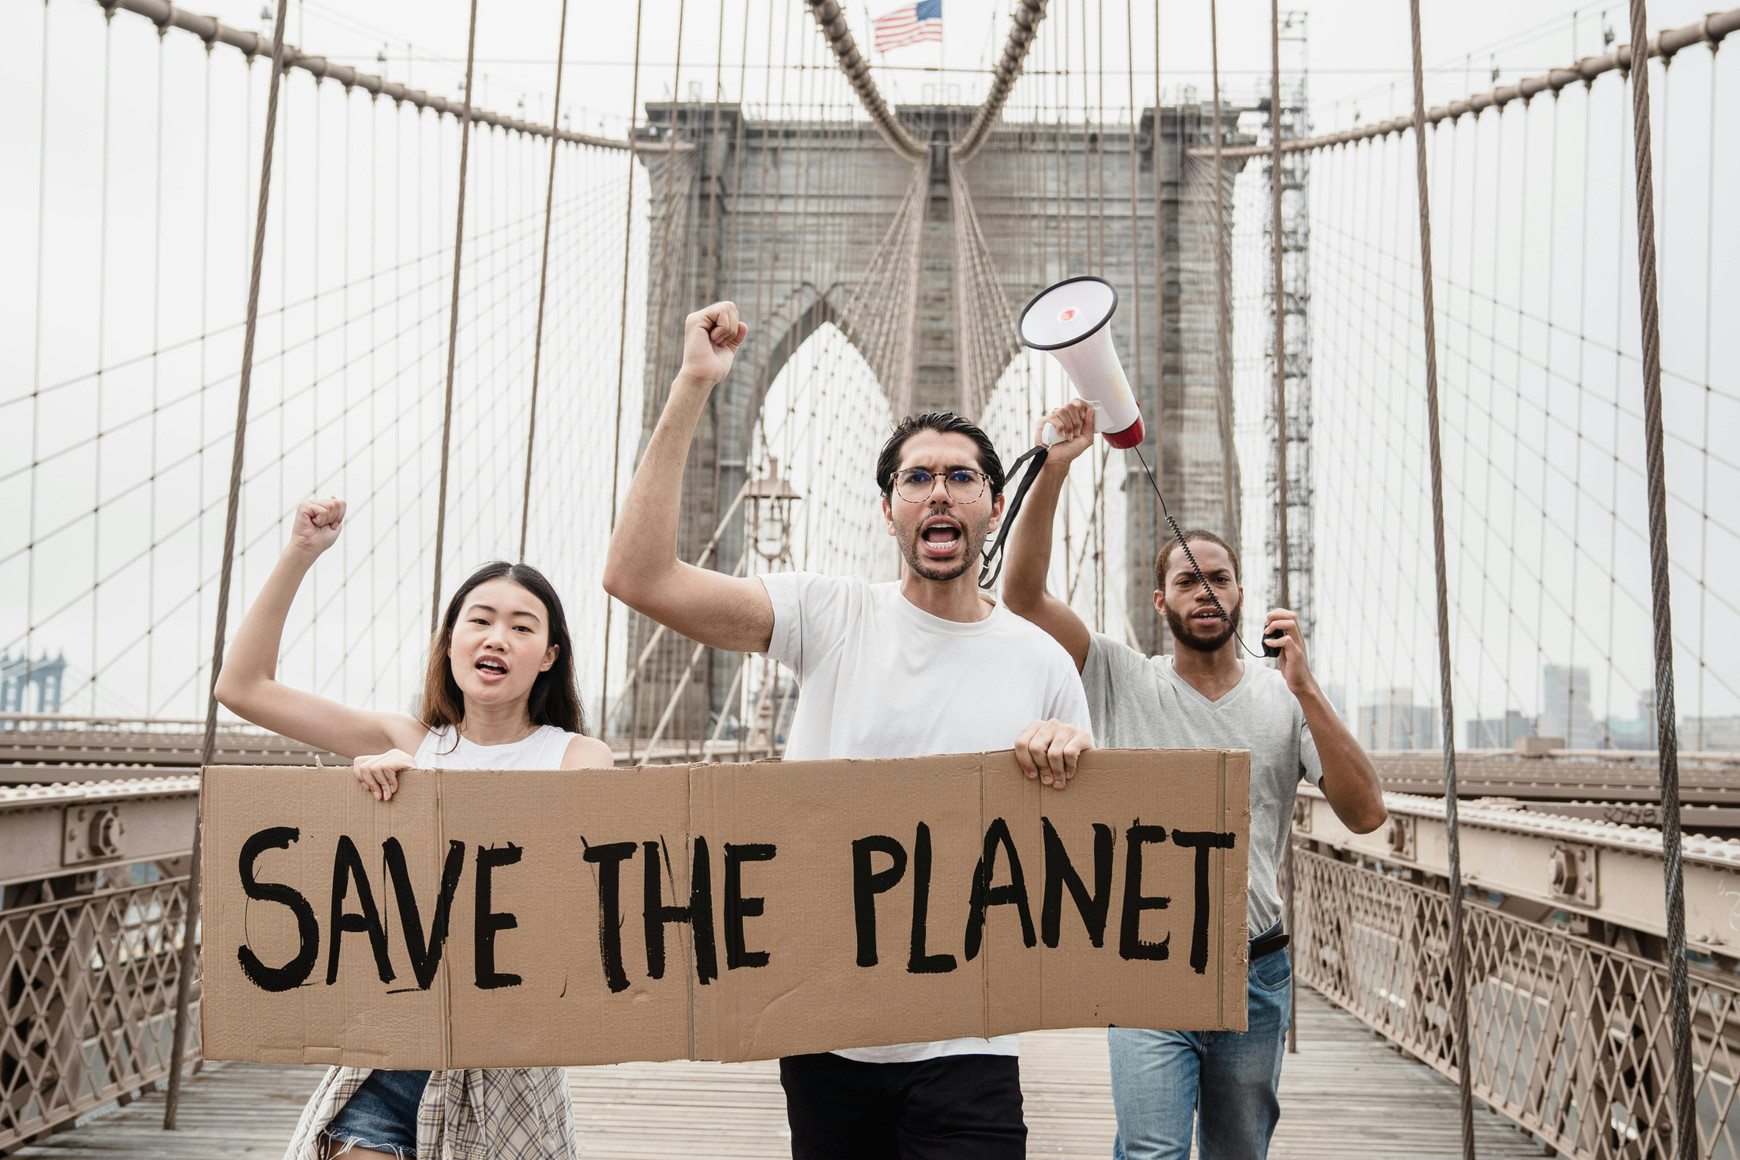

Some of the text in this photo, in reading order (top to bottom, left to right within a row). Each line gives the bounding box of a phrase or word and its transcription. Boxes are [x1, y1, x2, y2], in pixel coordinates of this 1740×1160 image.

[238, 816, 1237, 993] SAVE THE PLANET
